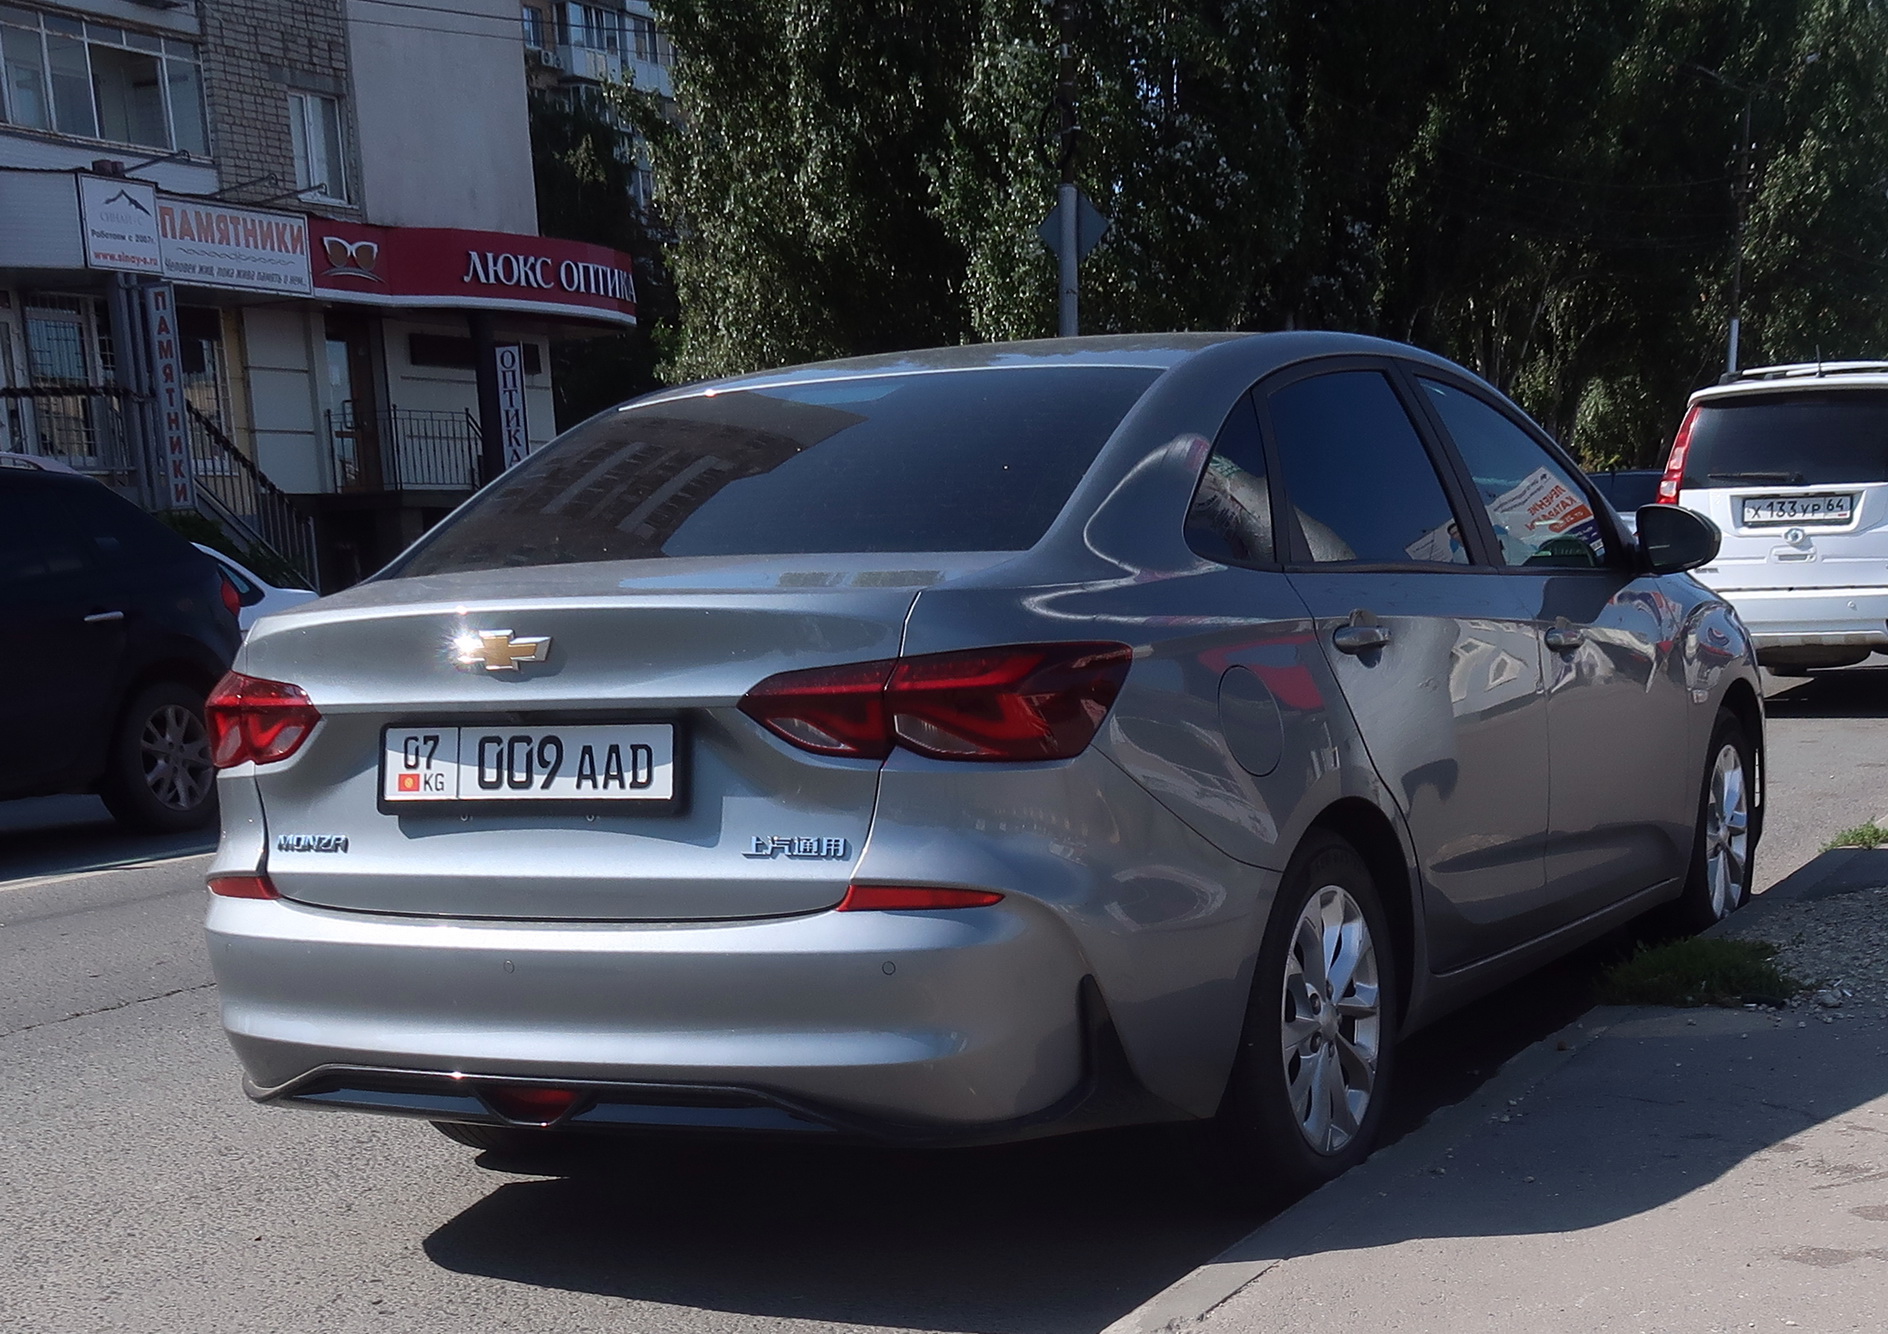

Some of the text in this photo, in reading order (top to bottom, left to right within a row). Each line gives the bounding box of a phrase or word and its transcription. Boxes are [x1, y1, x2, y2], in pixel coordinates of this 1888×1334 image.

[158, 205, 305, 256] ПАМЯТНИКИ
[463, 251, 637, 304] ЛЮКС ОПТИКА
[154, 291, 188, 502] ПАМЯТНИКИ
[500, 350, 522, 467] ОПТИКА
[1826, 499, 1844, 511] 64
[403, 735, 439, 770] 07
[478, 735, 653, 790] 009 AAD
[423, 773, 445, 792] KG
[277, 834, 349, 853] MONZA
[741, 836, 850, 860] 上汽通用
